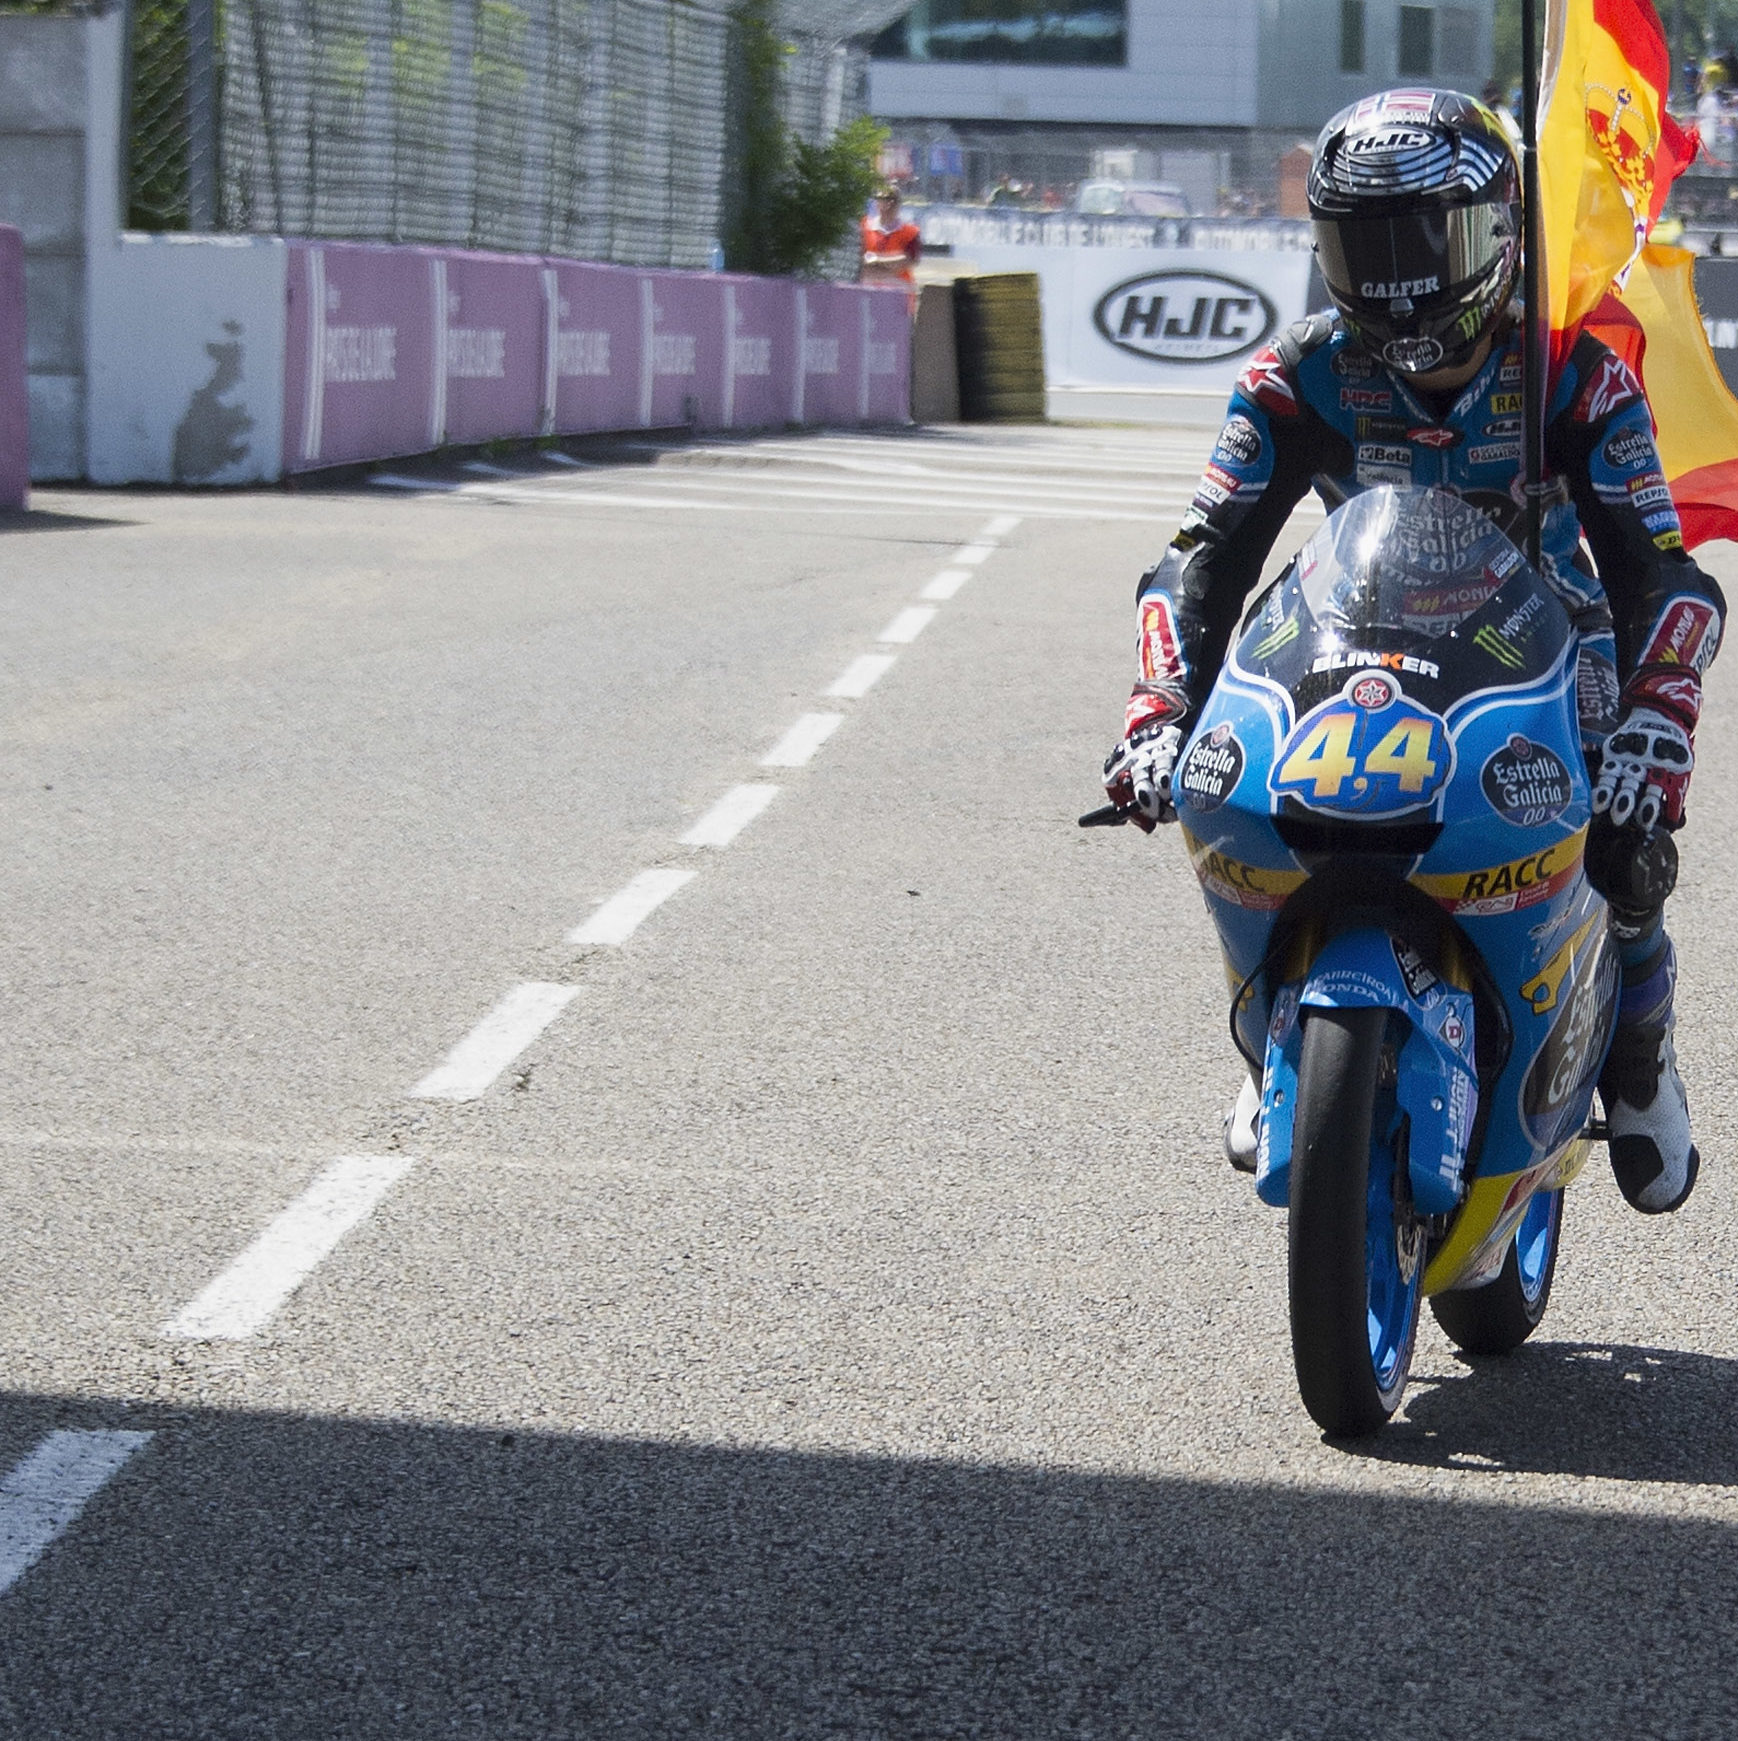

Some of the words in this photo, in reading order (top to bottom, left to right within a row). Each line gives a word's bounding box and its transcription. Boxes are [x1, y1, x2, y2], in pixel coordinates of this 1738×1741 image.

[1354, 132, 1424, 152] HJC
[1361, 275, 1440, 298] GALFER
[1118, 296, 1256, 341] HJC
[1374, 447, 1410, 464] Beta
[1608, 433, 1649, 456] Estrella
[1616, 444, 1653, 465] Galicia
[1635, 486, 1669, 503] REPSO
[1500, 592, 1544, 640] MONSTER
[1312, 651, 1440, 679] BLINKER
[1189, 742, 1235, 774] Estrella
[1493, 757, 1560, 784] Estrella
[1184, 766, 1223, 796] Galicia
[1503, 780, 1562, 808] Galicia
[1462, 848, 1555, 900] RACC
